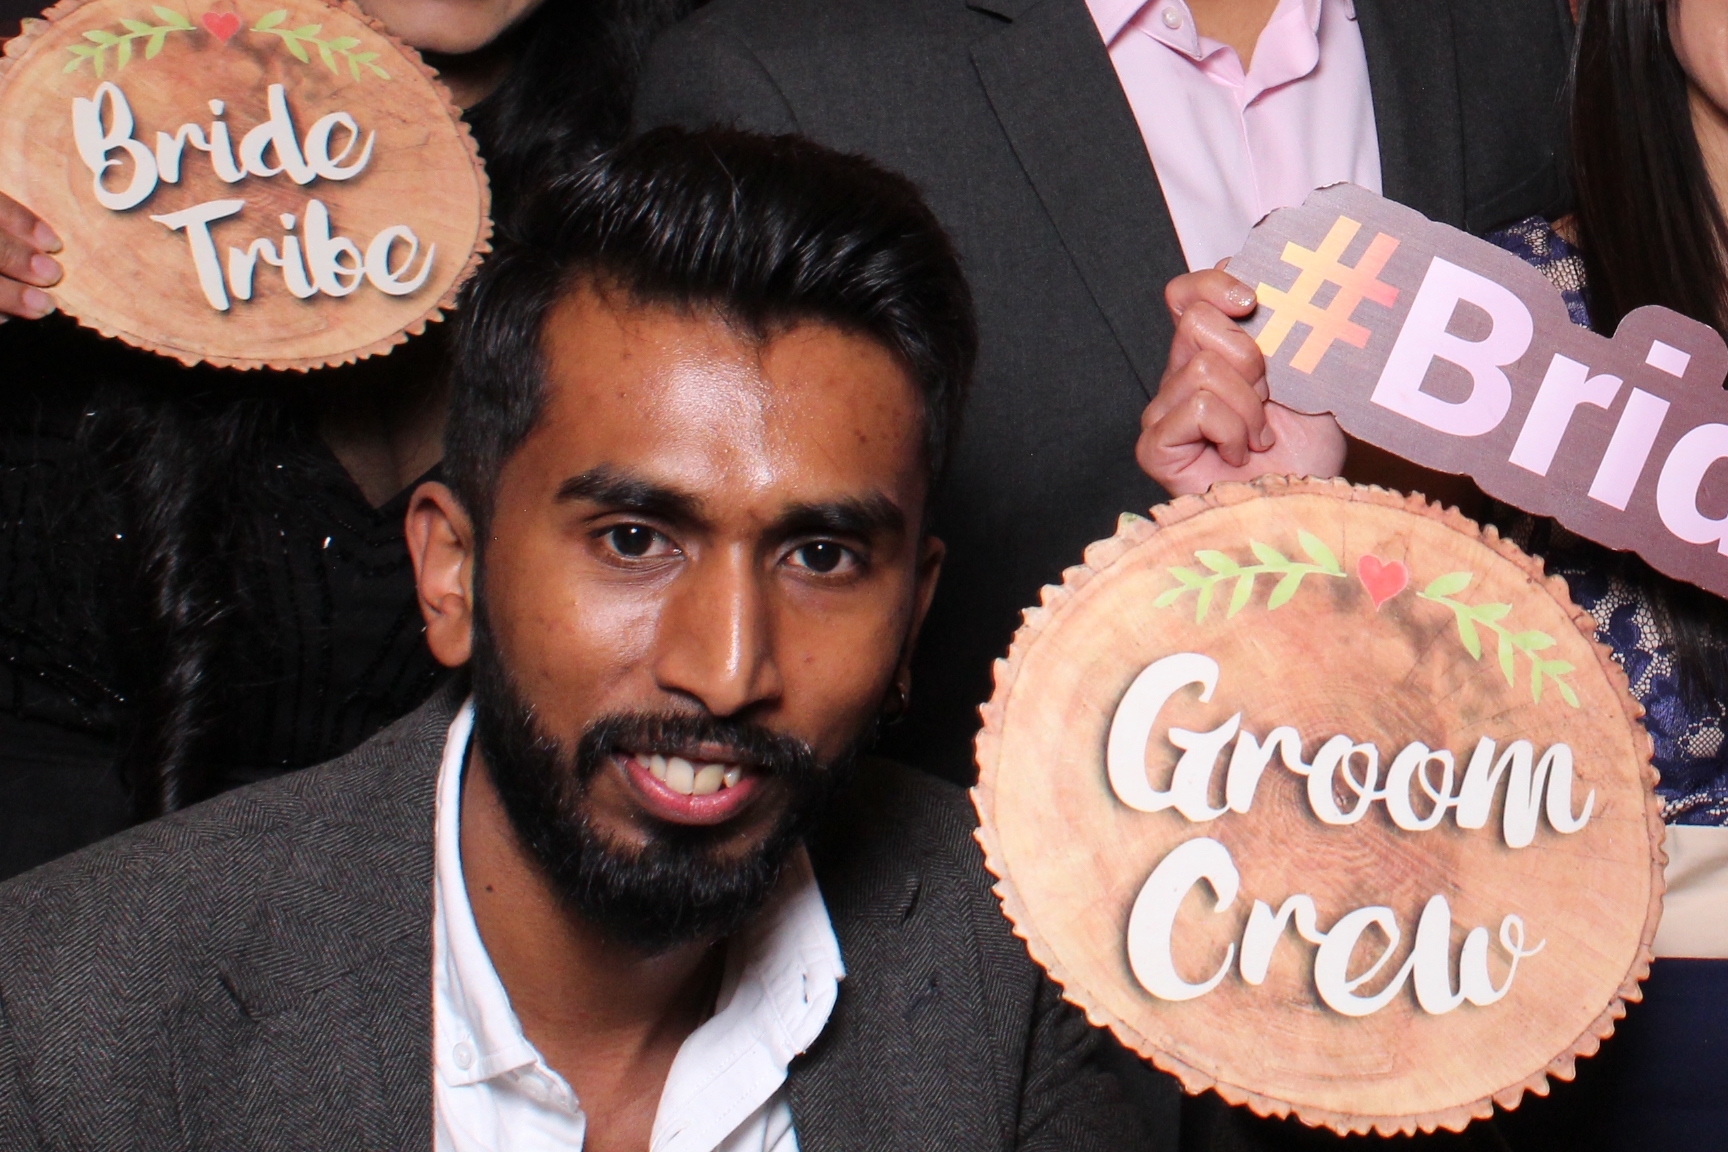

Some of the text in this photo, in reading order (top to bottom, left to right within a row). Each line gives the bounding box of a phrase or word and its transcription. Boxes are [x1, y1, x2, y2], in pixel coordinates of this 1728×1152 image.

[72, 81, 375, 211] Bride
[150, 198, 436, 311] Tribe
[1106, 652, 1595, 849] Groom
[1127, 837, 1546, 1017] Crew
